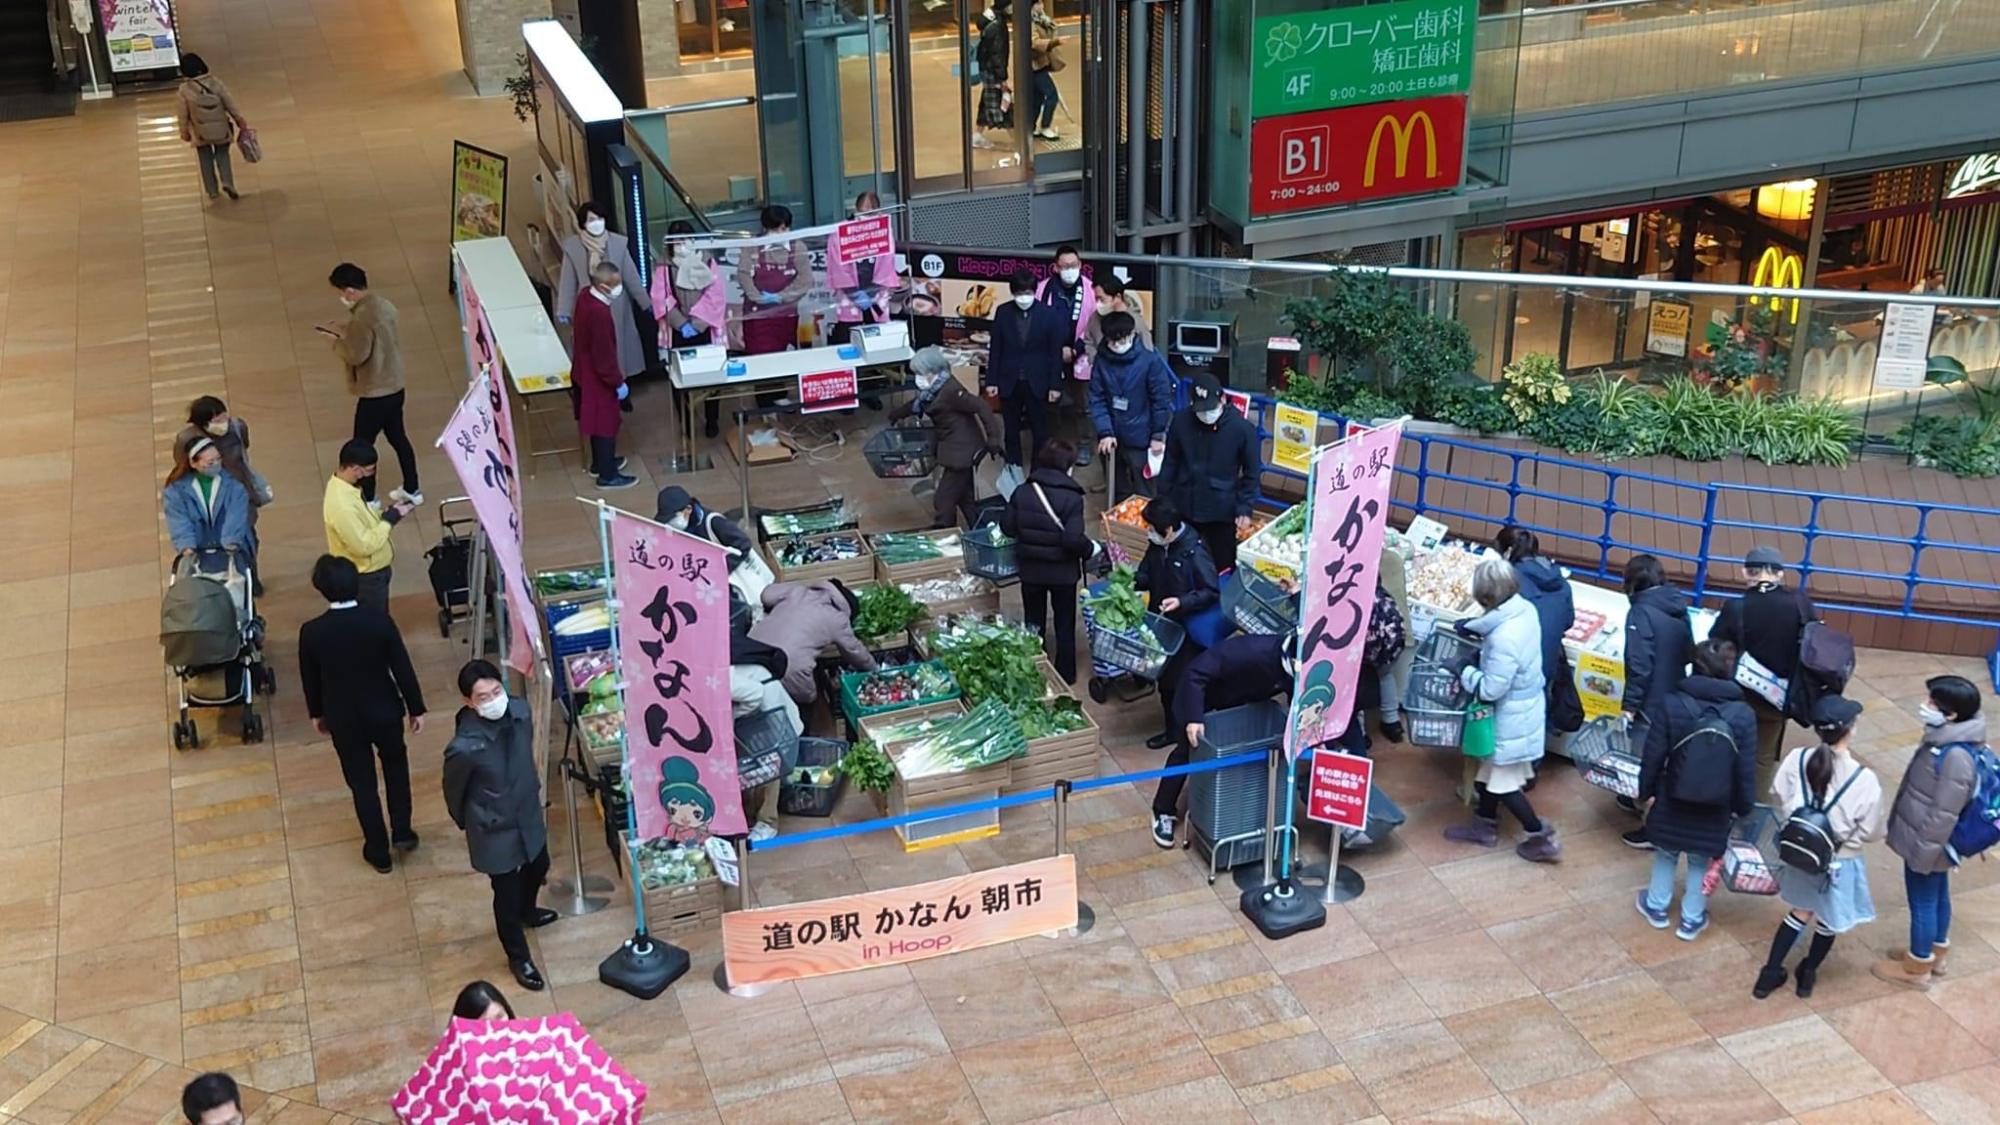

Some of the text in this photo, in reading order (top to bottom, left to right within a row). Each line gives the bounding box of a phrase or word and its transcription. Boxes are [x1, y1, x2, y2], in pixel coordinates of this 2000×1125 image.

[1304, 5, 1464, 54] クローバー歯科
[1372, 38, 1462, 74] 矯正歯科
[1285, 74, 1311, 97] 4F
[1285, 135, 1322, 176] B1
[923, 260, 943, 272] B1F
[1329, 446, 1391, 495] 道の駅
[628, 539, 711, 586] 道の駅
[1302, 495, 1379, 664] かなん
[638, 585, 713, 755] かなん
[762, 877, 1043, 953] 道の駅 かなん 朝市
[862, 935, 952, 960] in Hoop
